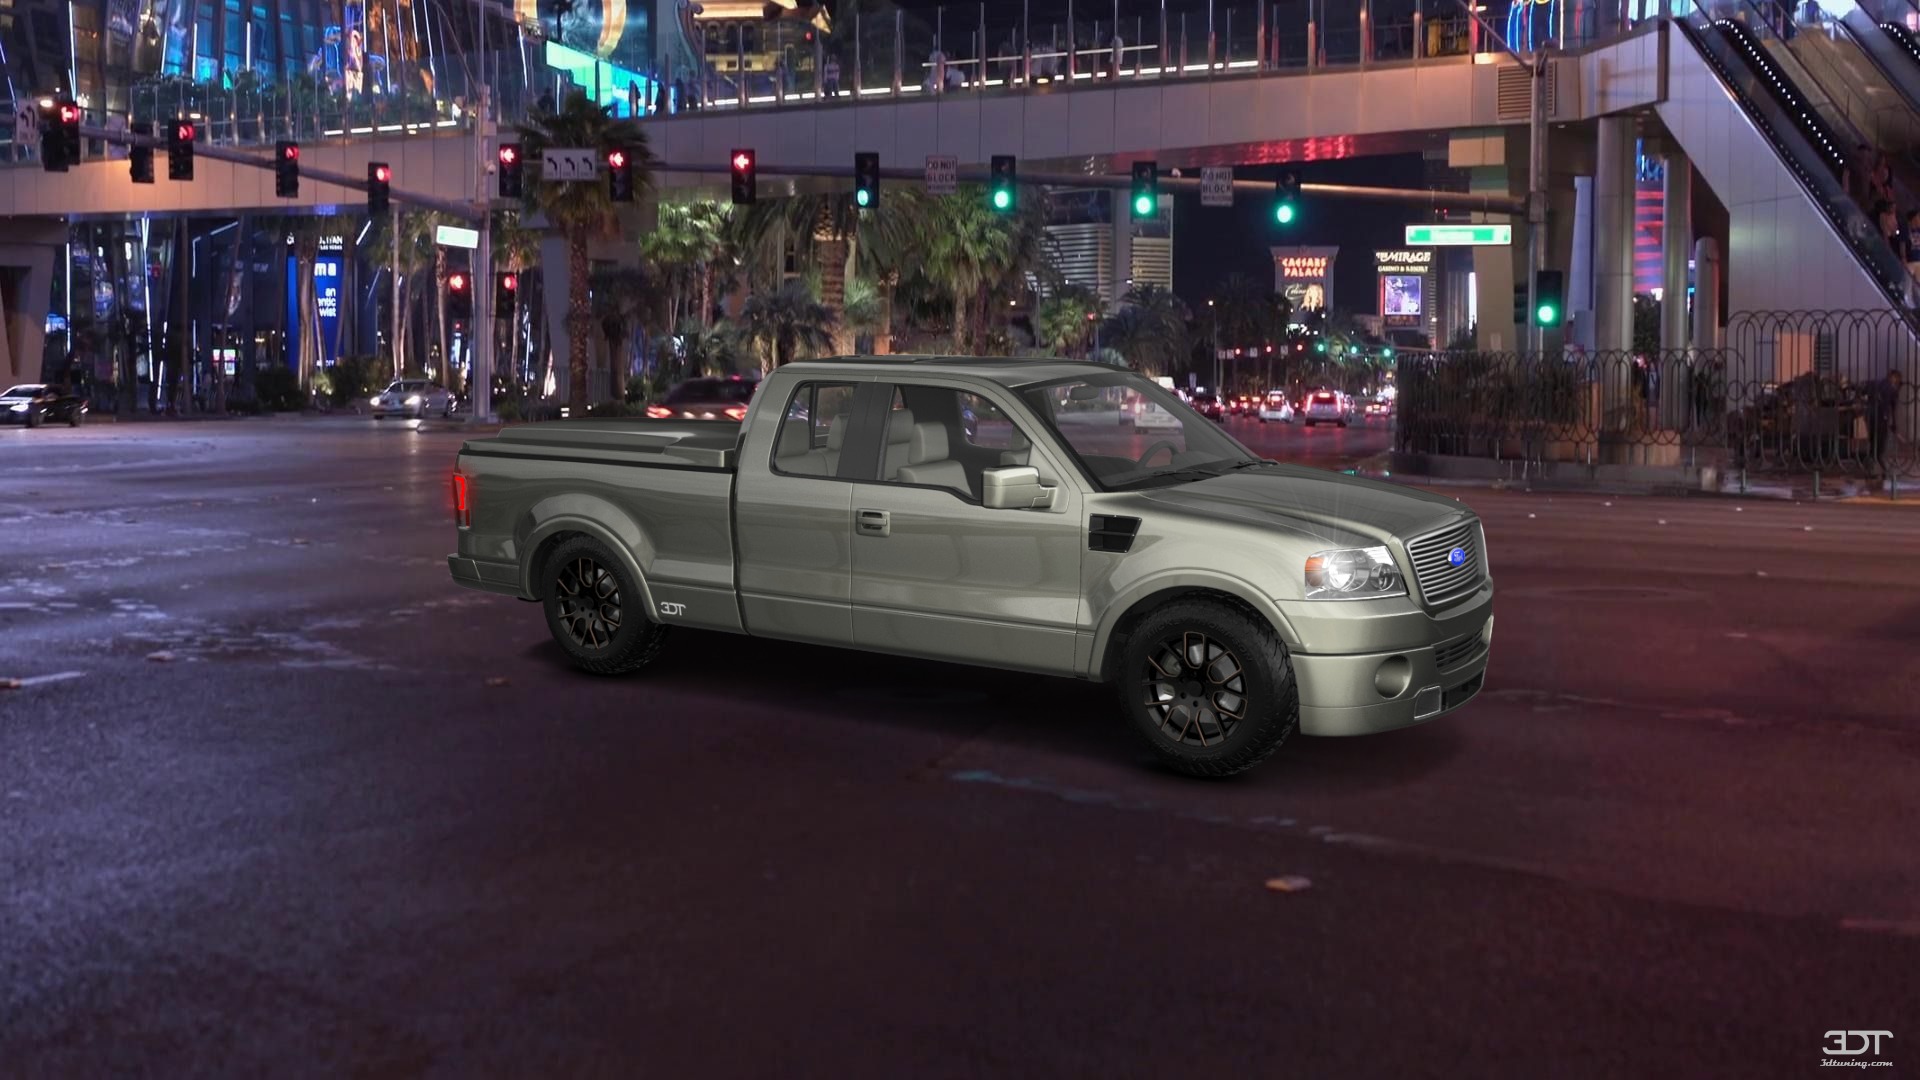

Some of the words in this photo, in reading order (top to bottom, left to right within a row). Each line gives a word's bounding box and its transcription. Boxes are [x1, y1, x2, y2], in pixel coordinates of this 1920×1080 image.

[927, 174, 956, 182] BLOCK
[1202, 183, 1231, 192] BLOCK
[1281, 257, 1327, 267] CAESARS
[1382, 251, 1431, 263] MIRAGE
[1284, 267, 1325, 277] PALACE
[660, 601, 687, 616] 3DT
